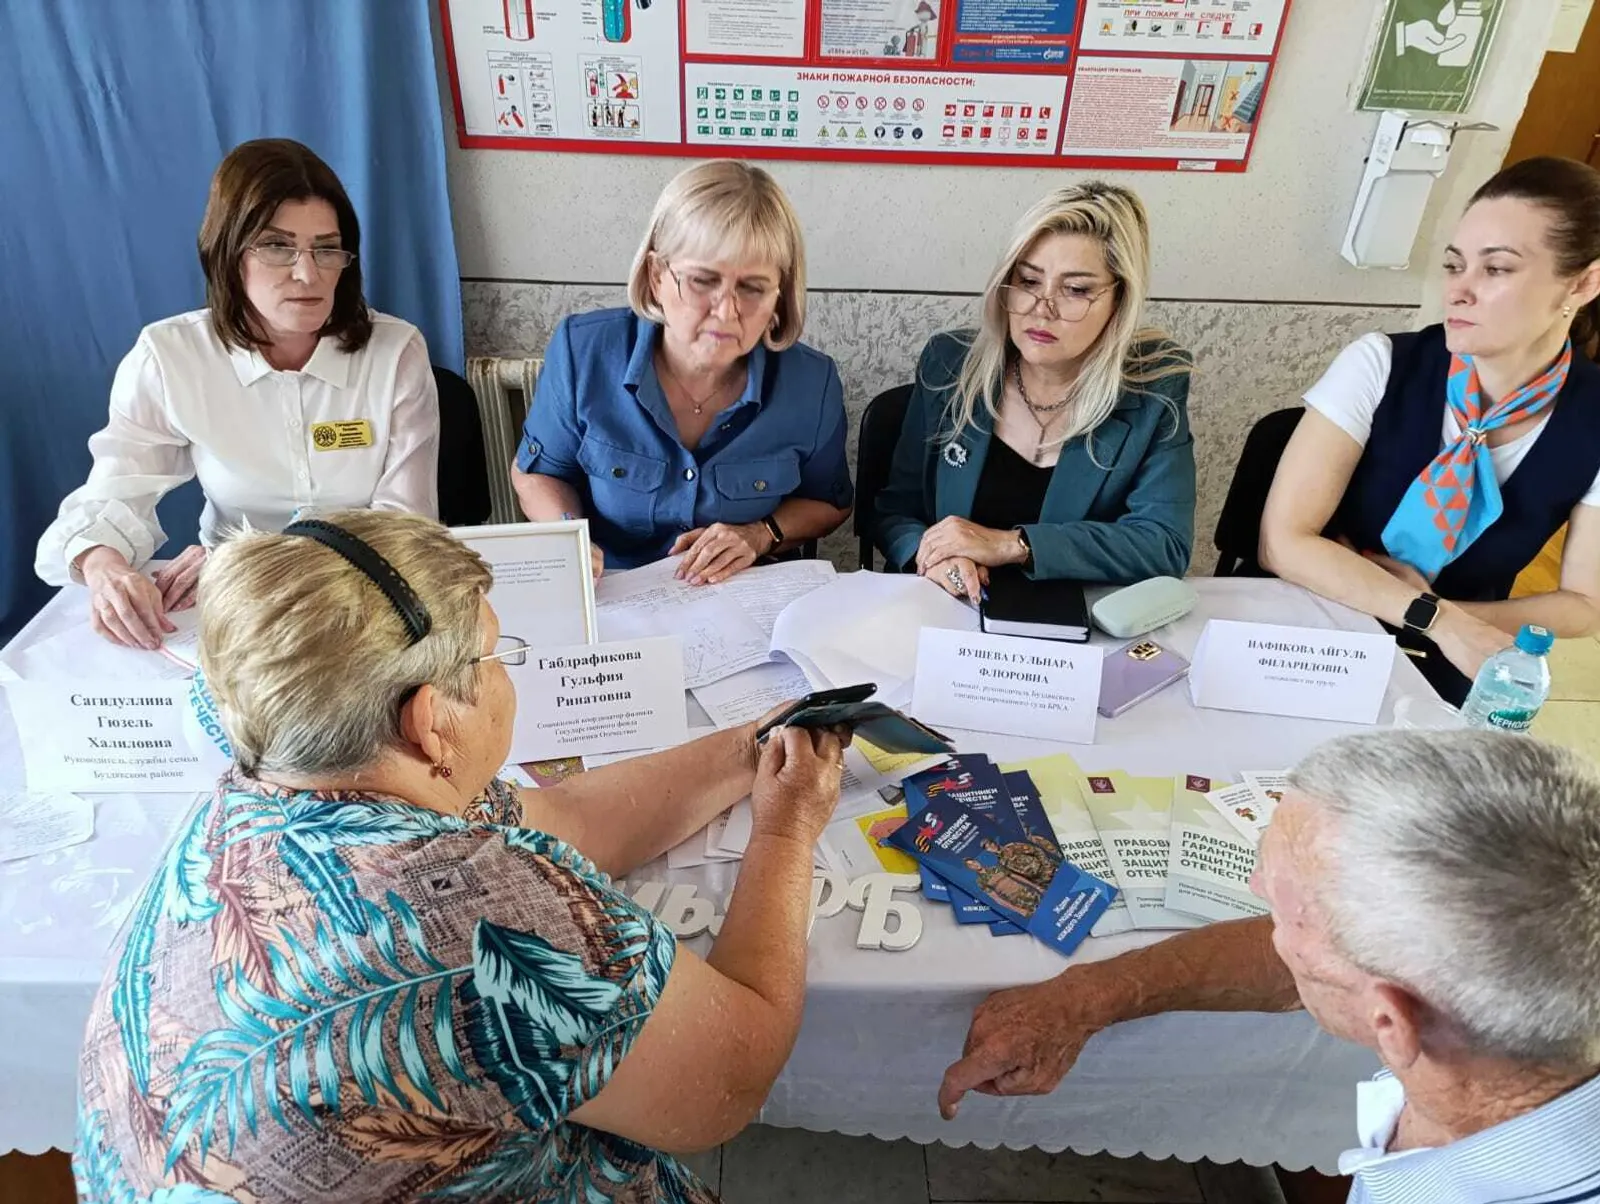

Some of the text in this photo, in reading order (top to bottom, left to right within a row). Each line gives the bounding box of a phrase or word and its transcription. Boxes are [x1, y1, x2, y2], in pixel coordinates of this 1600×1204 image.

[1145, 10, 1179, 18] ПОЖАРЕ
[1200, 12, 1236, 21] СЛЕДУЕТ
[797, 72, 975, 87] ЗНАКИ ПОЖАРНОЙ БЕЗОПАСНОСТИ:
[1248, 639, 1367, 660] НАФИКОВА АЙГУЛЬ
[538, 651, 642, 670] Габдрафикова
[958, 647, 1074, 670] ЯУШЕВА ГУЛЬНАРА
[1258, 657, 1349, 675] ФИЛАРИДОВНА
[561, 672, 624, 689] Гульфия
[979, 668, 1049, 684] ФЛЮРОВНА
[70, 694, 173, 709] Сагидуллина
[556, 691, 632, 707] Ринатовна
[98, 716, 153, 728] Гюзель
[87, 737, 172, 749] Халиловна
[1060, 839, 1101, 852] РАВОВ
[1114, 839, 1170, 847] ПРАВОВ
[1065, 849, 1106, 862] АРАНТ
[1117, 849, 1169, 858] ГАРАНТ
[1182, 841, 1255, 866] ГАРАНТИИ
[1122, 859, 1169, 868] ЗАЩИТ
[1181, 850, 1252, 875] ЗАЩИТНИ
[1126, 869, 1168, 878] ОТЕЧЕ
